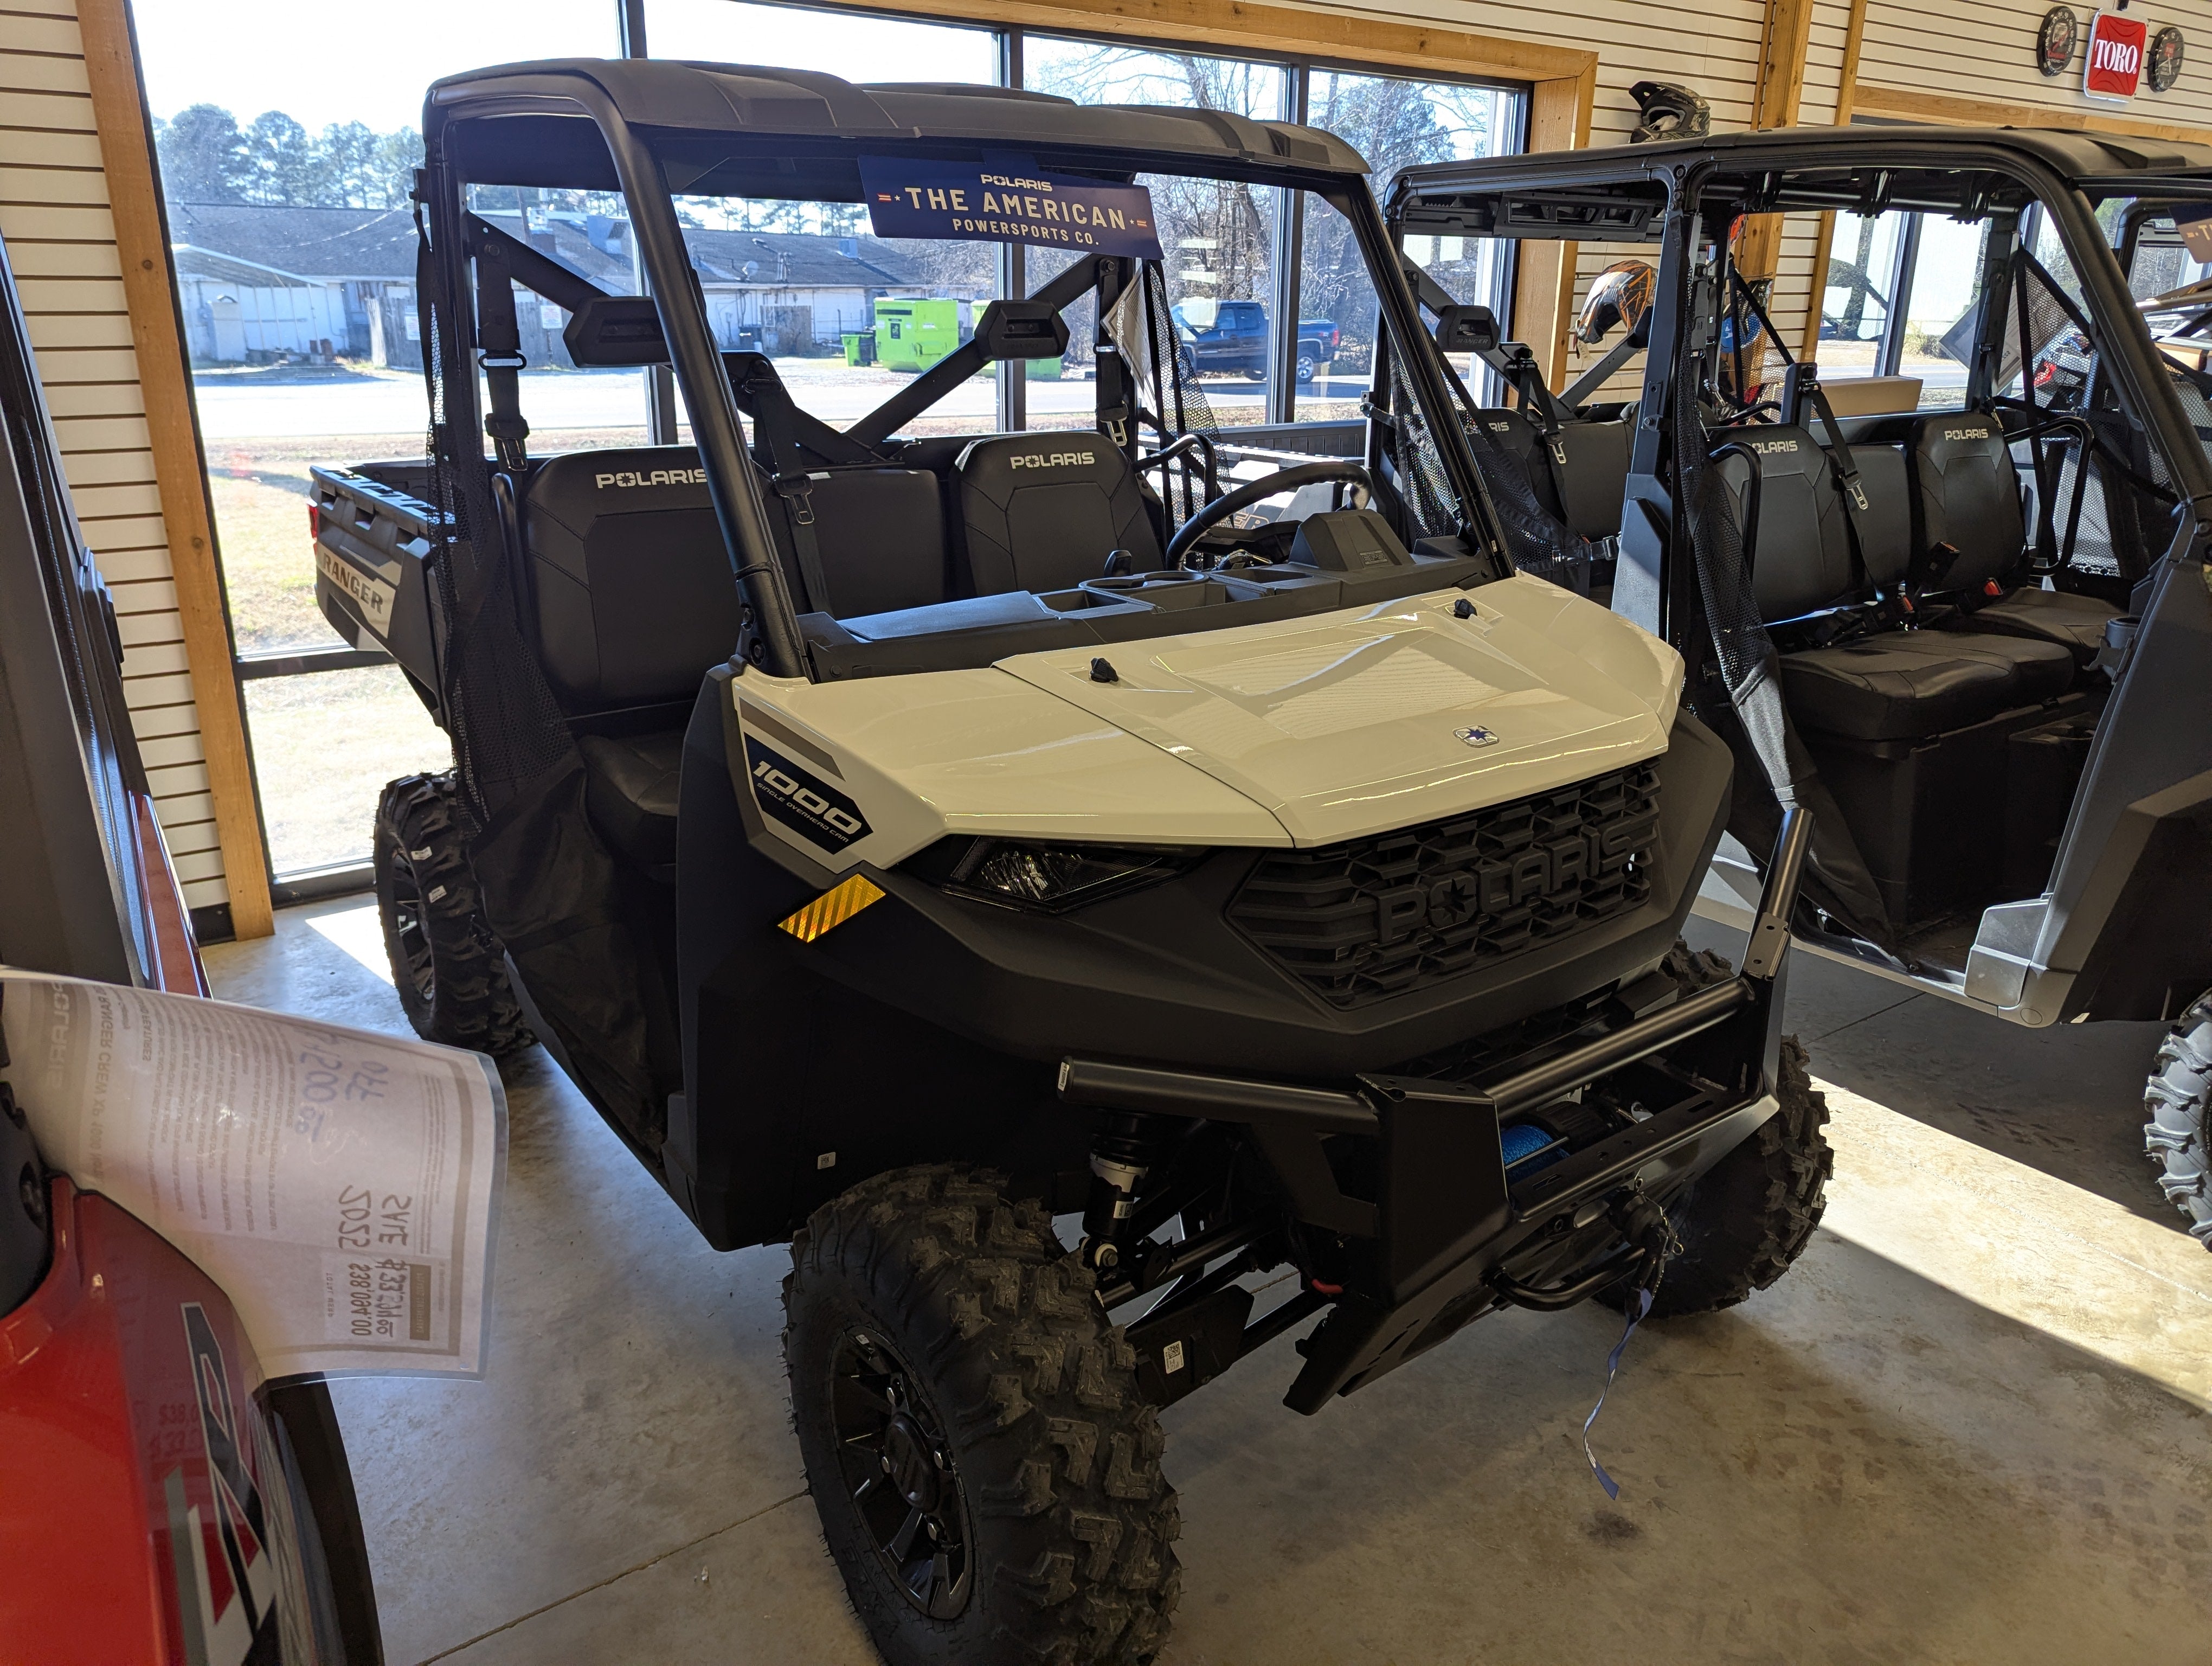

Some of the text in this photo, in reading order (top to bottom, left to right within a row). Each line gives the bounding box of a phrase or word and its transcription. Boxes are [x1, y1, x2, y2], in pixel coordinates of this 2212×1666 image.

[2094, 39, 2138, 74] TORO
[980, 174, 1053, 192] POLARIS
[904, 187, 1126, 230] THE AMERICAN
[953, 218, 1099, 245] POWERSPORTS CO.
[1750, 440, 1798, 455] OLARIS
[1945, 428, 1989, 441] POLARIS
[1009, 452, 1095, 469] POLARIS
[595, 469, 708, 489] POLARIS
[322, 553, 384, 614] RANGER
[753, 760, 862, 835] 1000
[756, 782, 849, 843] SINGLE OVERHEAD CAM
[1374, 820, 1634, 944] POLARIS
